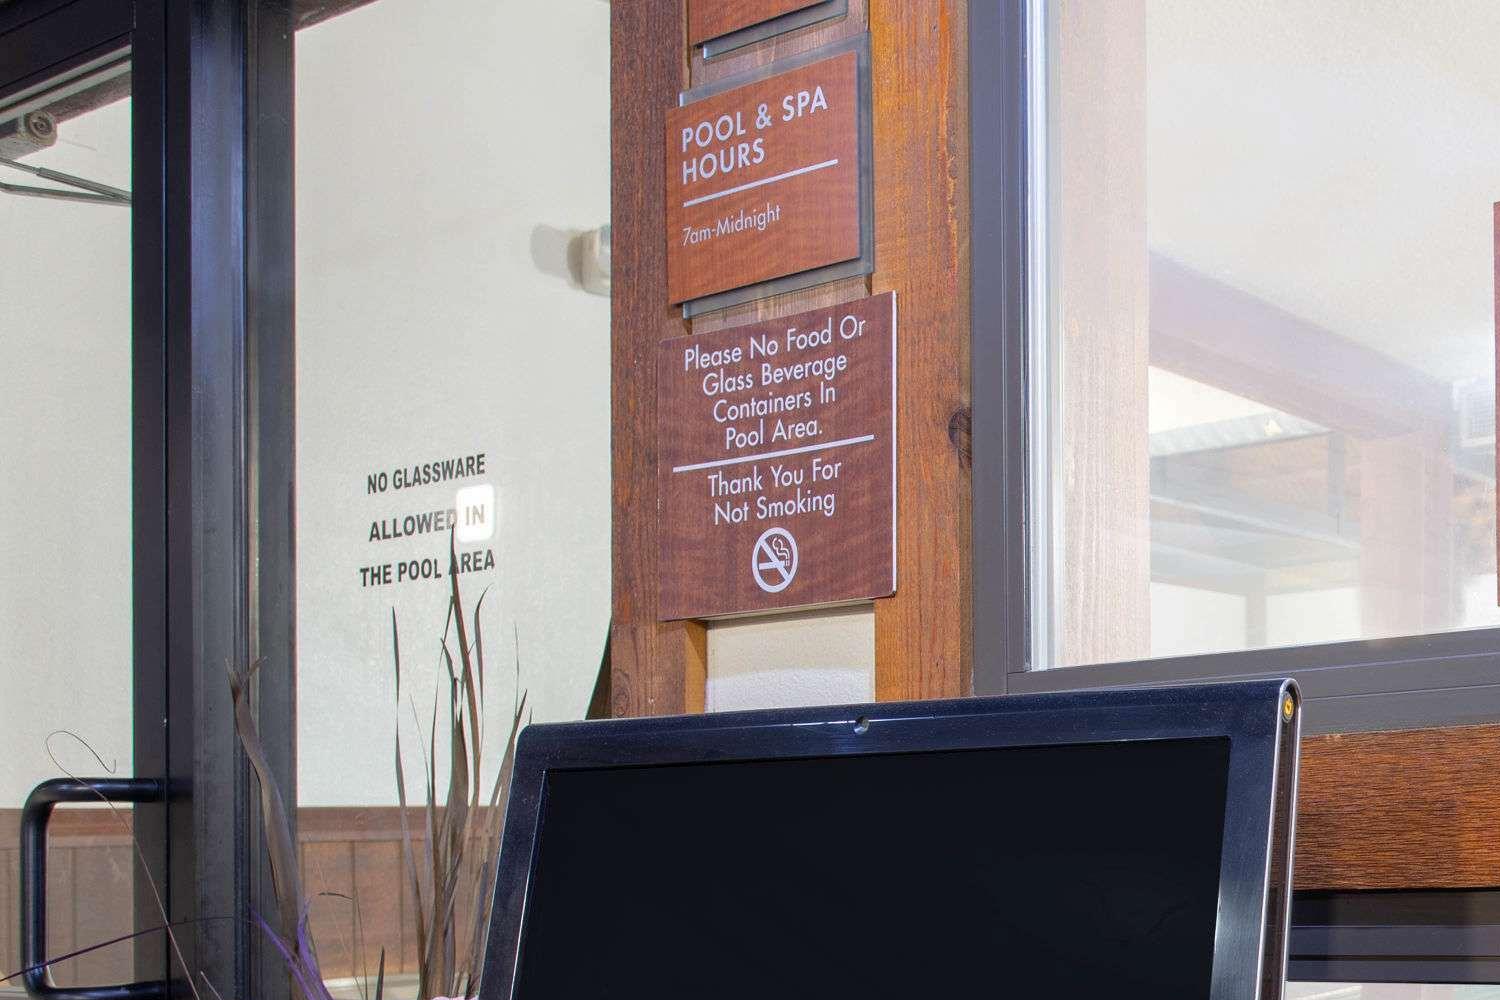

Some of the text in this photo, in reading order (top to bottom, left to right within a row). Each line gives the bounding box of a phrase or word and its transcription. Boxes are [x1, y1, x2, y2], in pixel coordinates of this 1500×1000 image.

[681, 85, 828, 152] POOL & SPA
[681, 137, 766, 185] HOURS
[682, 204, 782, 246] 7am-Midnight
[684, 315, 866, 371] Please No Food Or
[702, 354, 848, 397] Glass Beverage
[713, 381, 836, 424] Containers In
[725, 417, 823, 450] Pool Area.
[367, 452, 486, 495] NO GLASSWARE
[707, 457, 842, 498] Thank You For
[369, 503, 486, 542] ALLOWED IN
[714, 487, 836, 526] Not Smoking
[360, 549, 496, 587] THE POOL AREA
